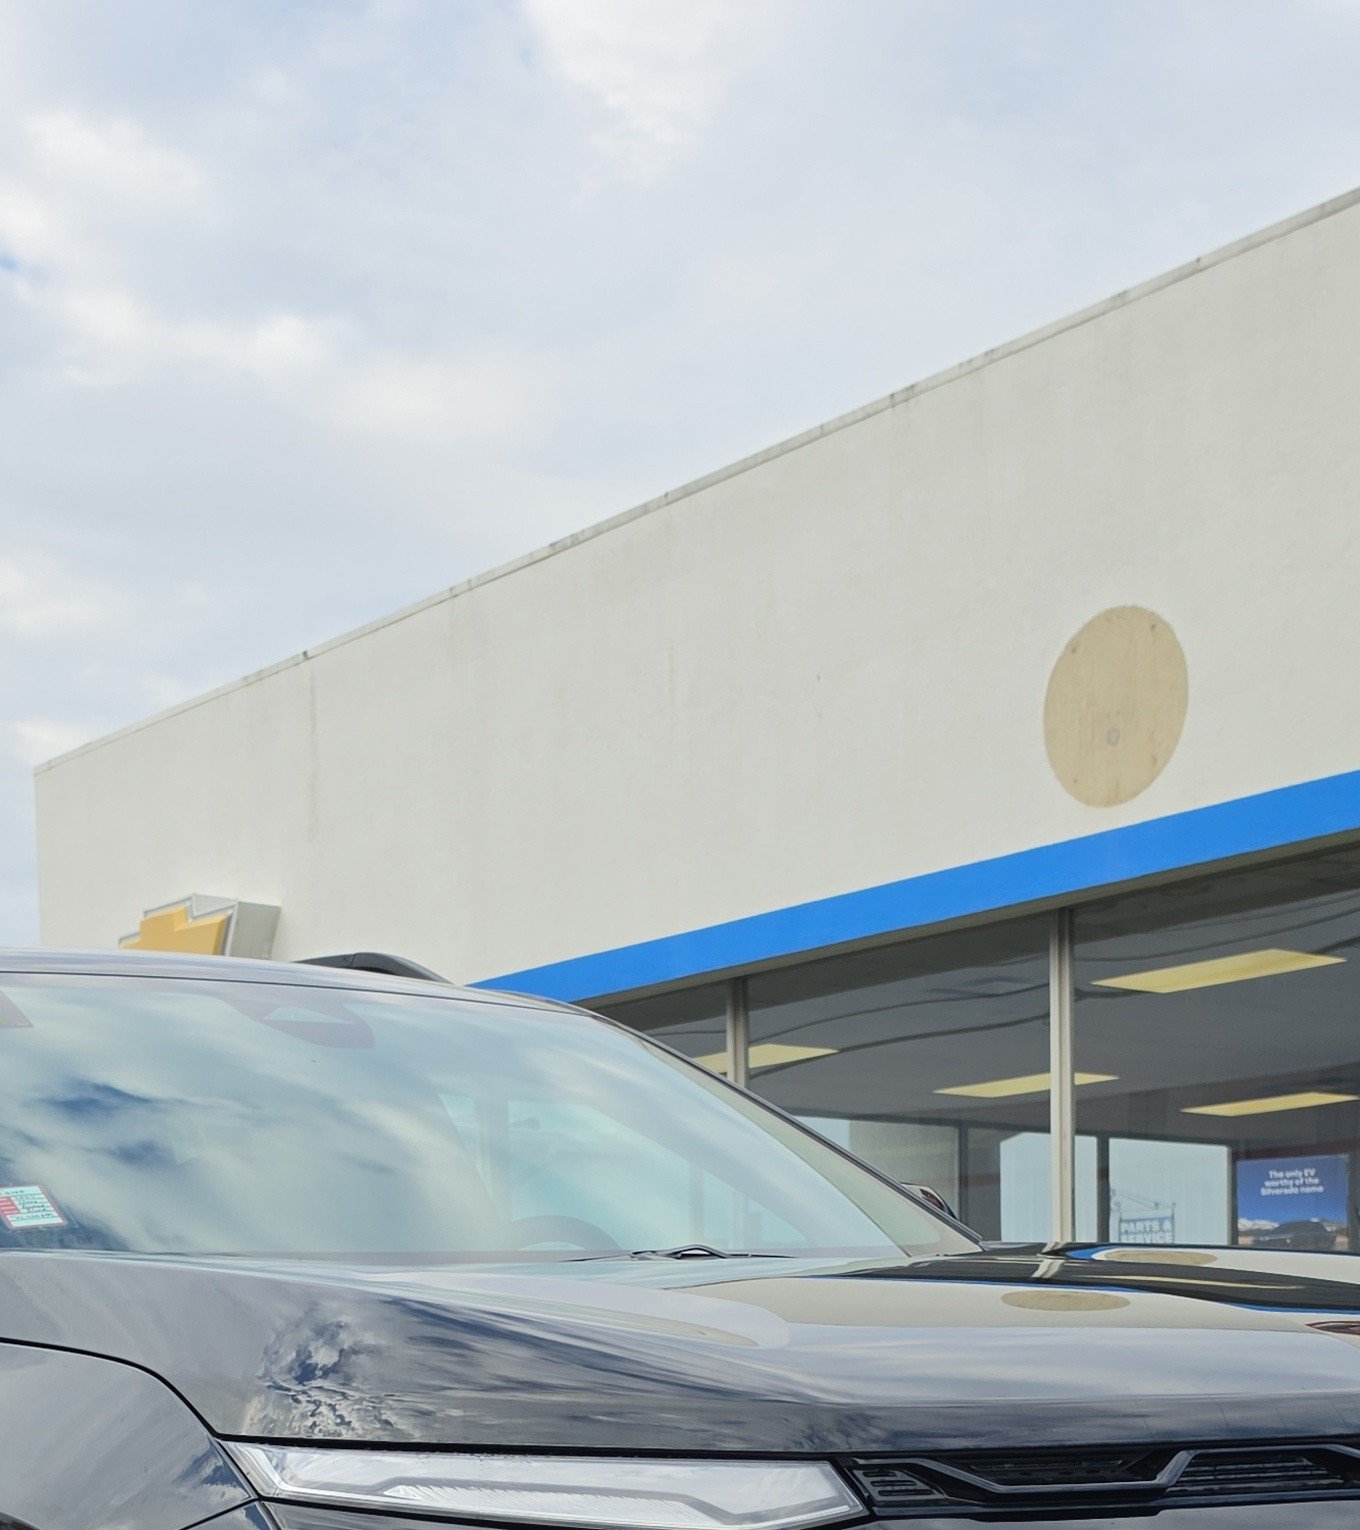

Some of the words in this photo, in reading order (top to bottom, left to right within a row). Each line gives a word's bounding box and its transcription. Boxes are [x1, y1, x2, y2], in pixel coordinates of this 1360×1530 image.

[1269, 1170, 1284, 1178] The
[1285, 1169, 1303, 1179] only
[1304, 1168, 1316, 1177] EV
[1264, 1179, 1293, 1188] worthy
[1294, 1177, 1304, 1186] of
[1305, 1177, 1320, 1185] the
[1121, 1221, 1160, 1234] PARTS
